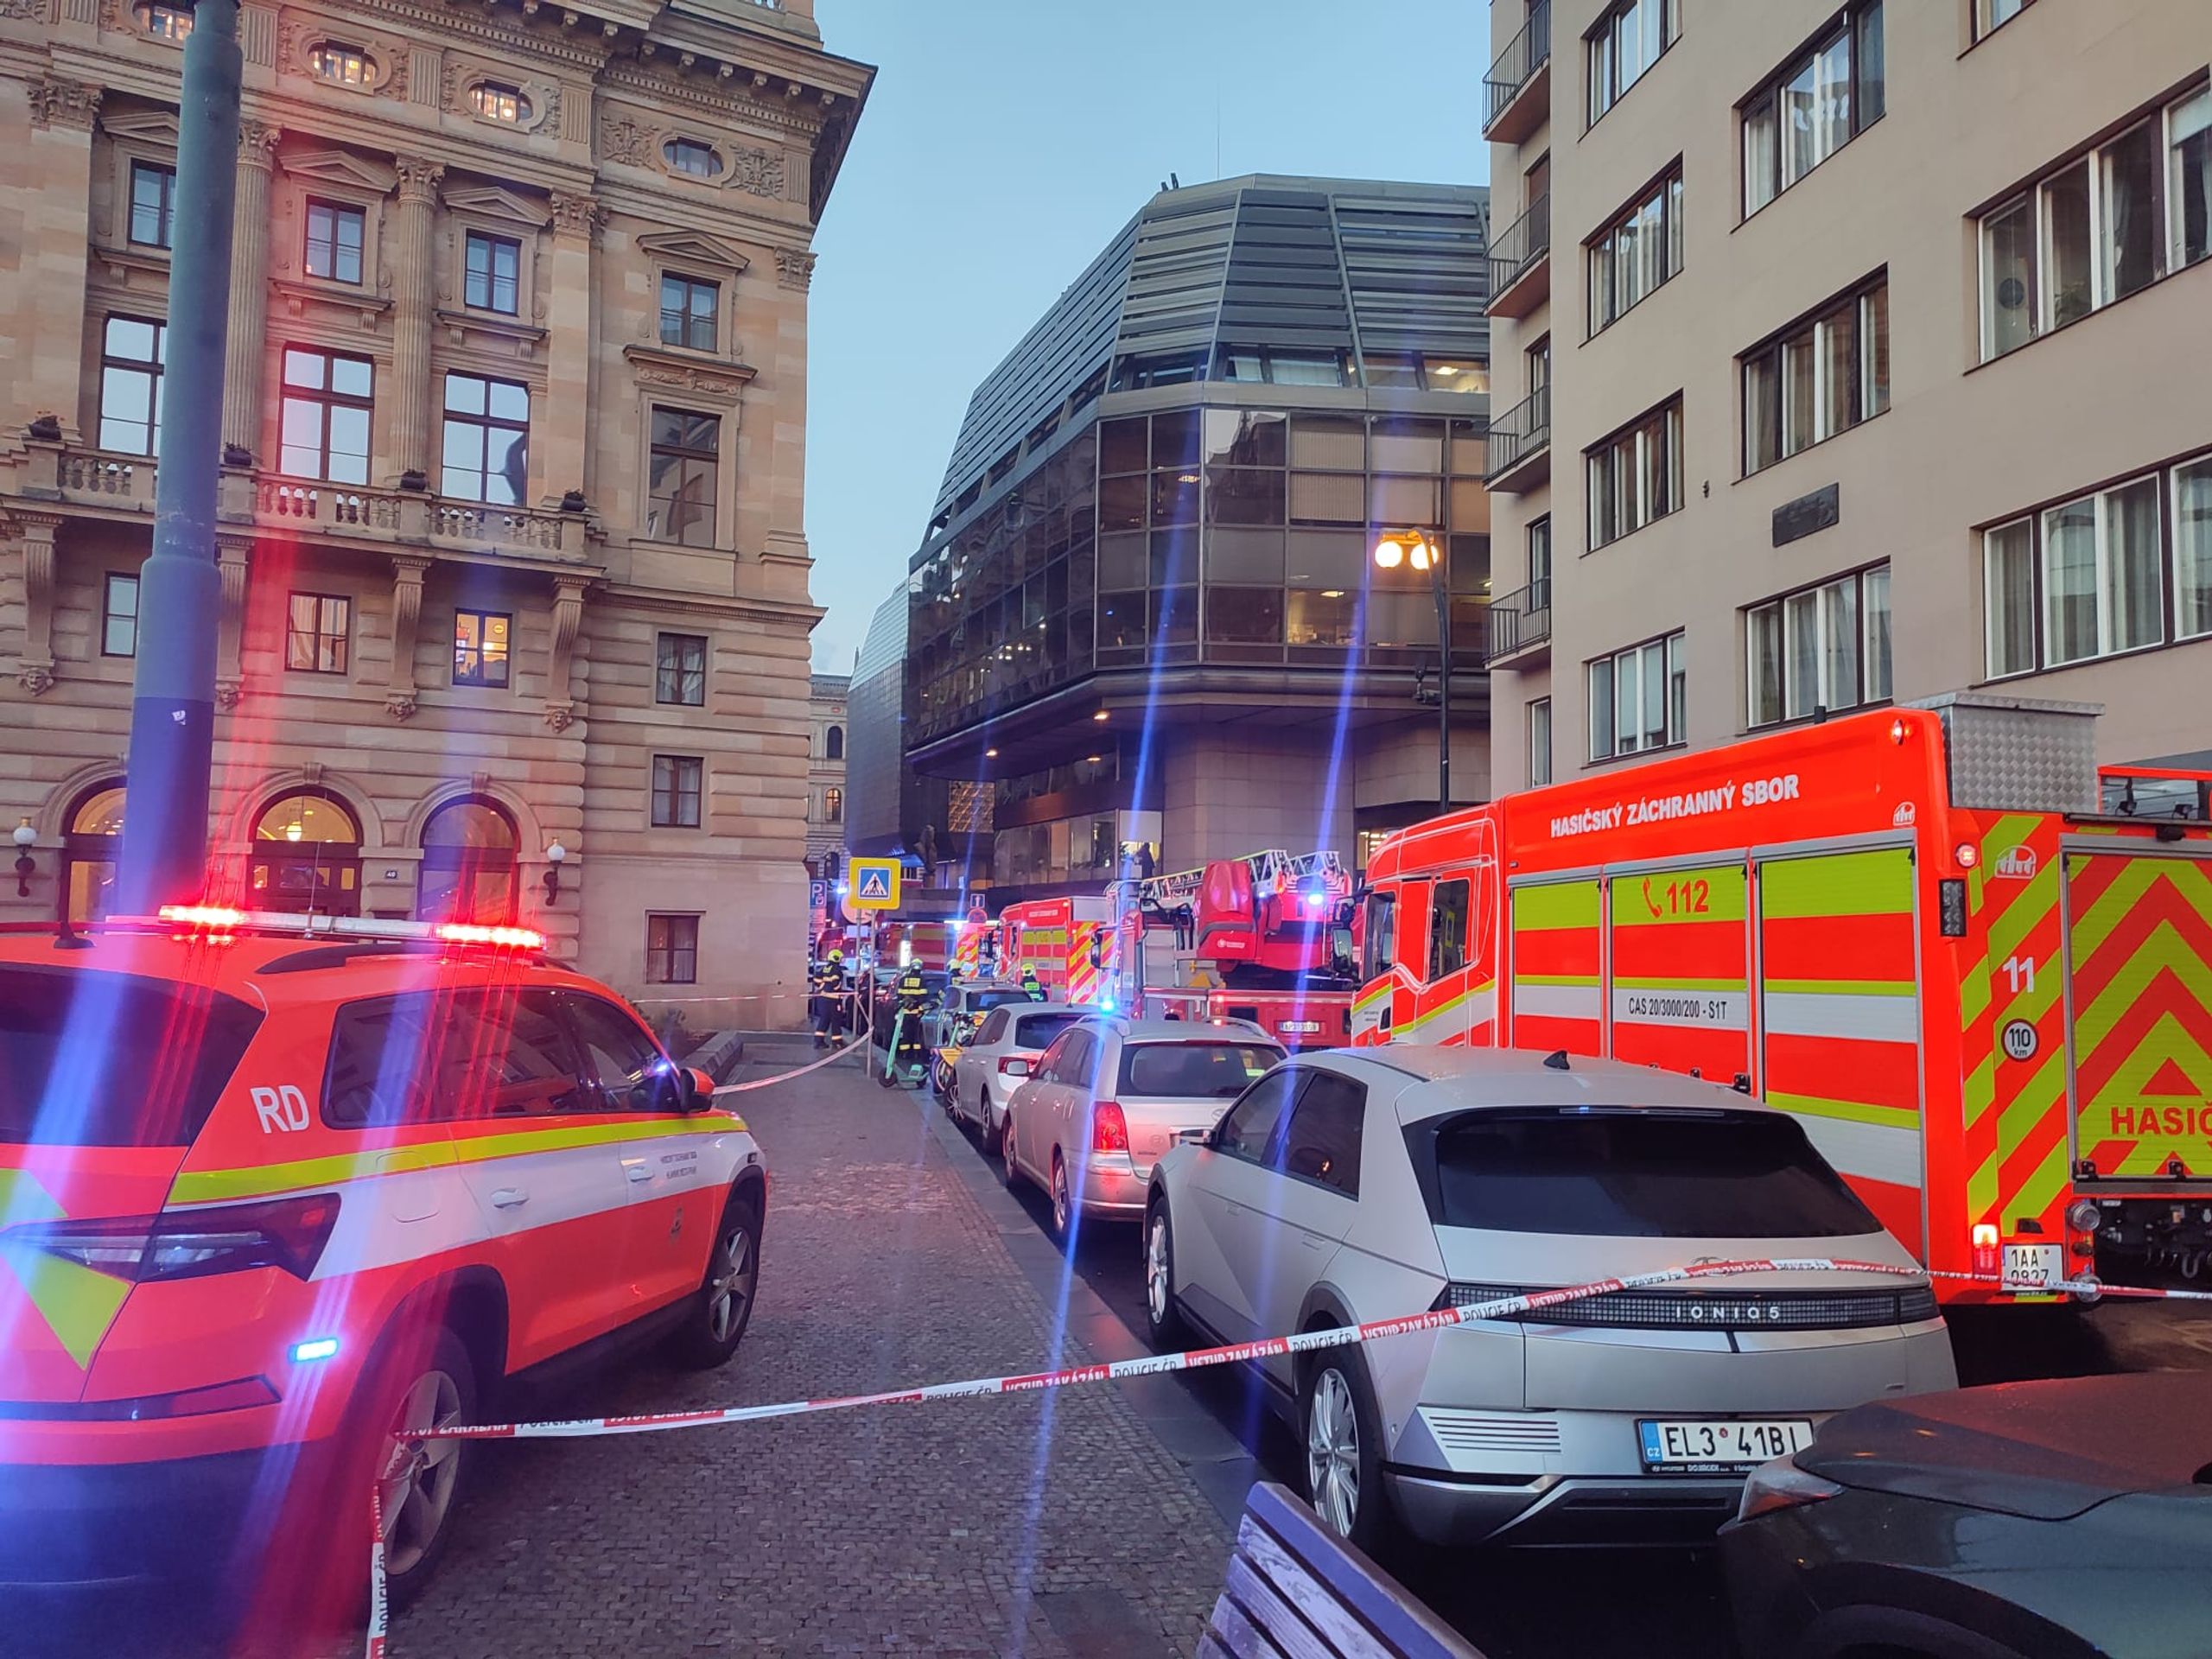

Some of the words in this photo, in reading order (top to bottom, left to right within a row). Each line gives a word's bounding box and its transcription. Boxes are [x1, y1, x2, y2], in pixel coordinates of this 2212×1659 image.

[1550, 801, 1623, 838] HASIČSKÝ
[1626, 780, 1737, 826] ZÁCHRANNÝ
[1741, 774, 1800, 807] SBOR
[1667, 879, 1710, 914] 112
[2002, 956, 2035, 993] 11
[1629, 997, 1647, 1015] CAS
[1649, 998, 1700, 1018] 20/3000/200
[1708, 1001, 1727, 1020] S1T
[2009, 1028, 2031, 1047] 110
[250, 1085, 309, 1134] RD
[2011, 1249, 2038, 1267] 1AA
[1676, 1306, 1760, 1319] IONIQ
[1770, 1306, 1780, 1319] 5
[1647, 1447, 1661, 1457] CZ
[1665, 1427, 1716, 1457] EL3
